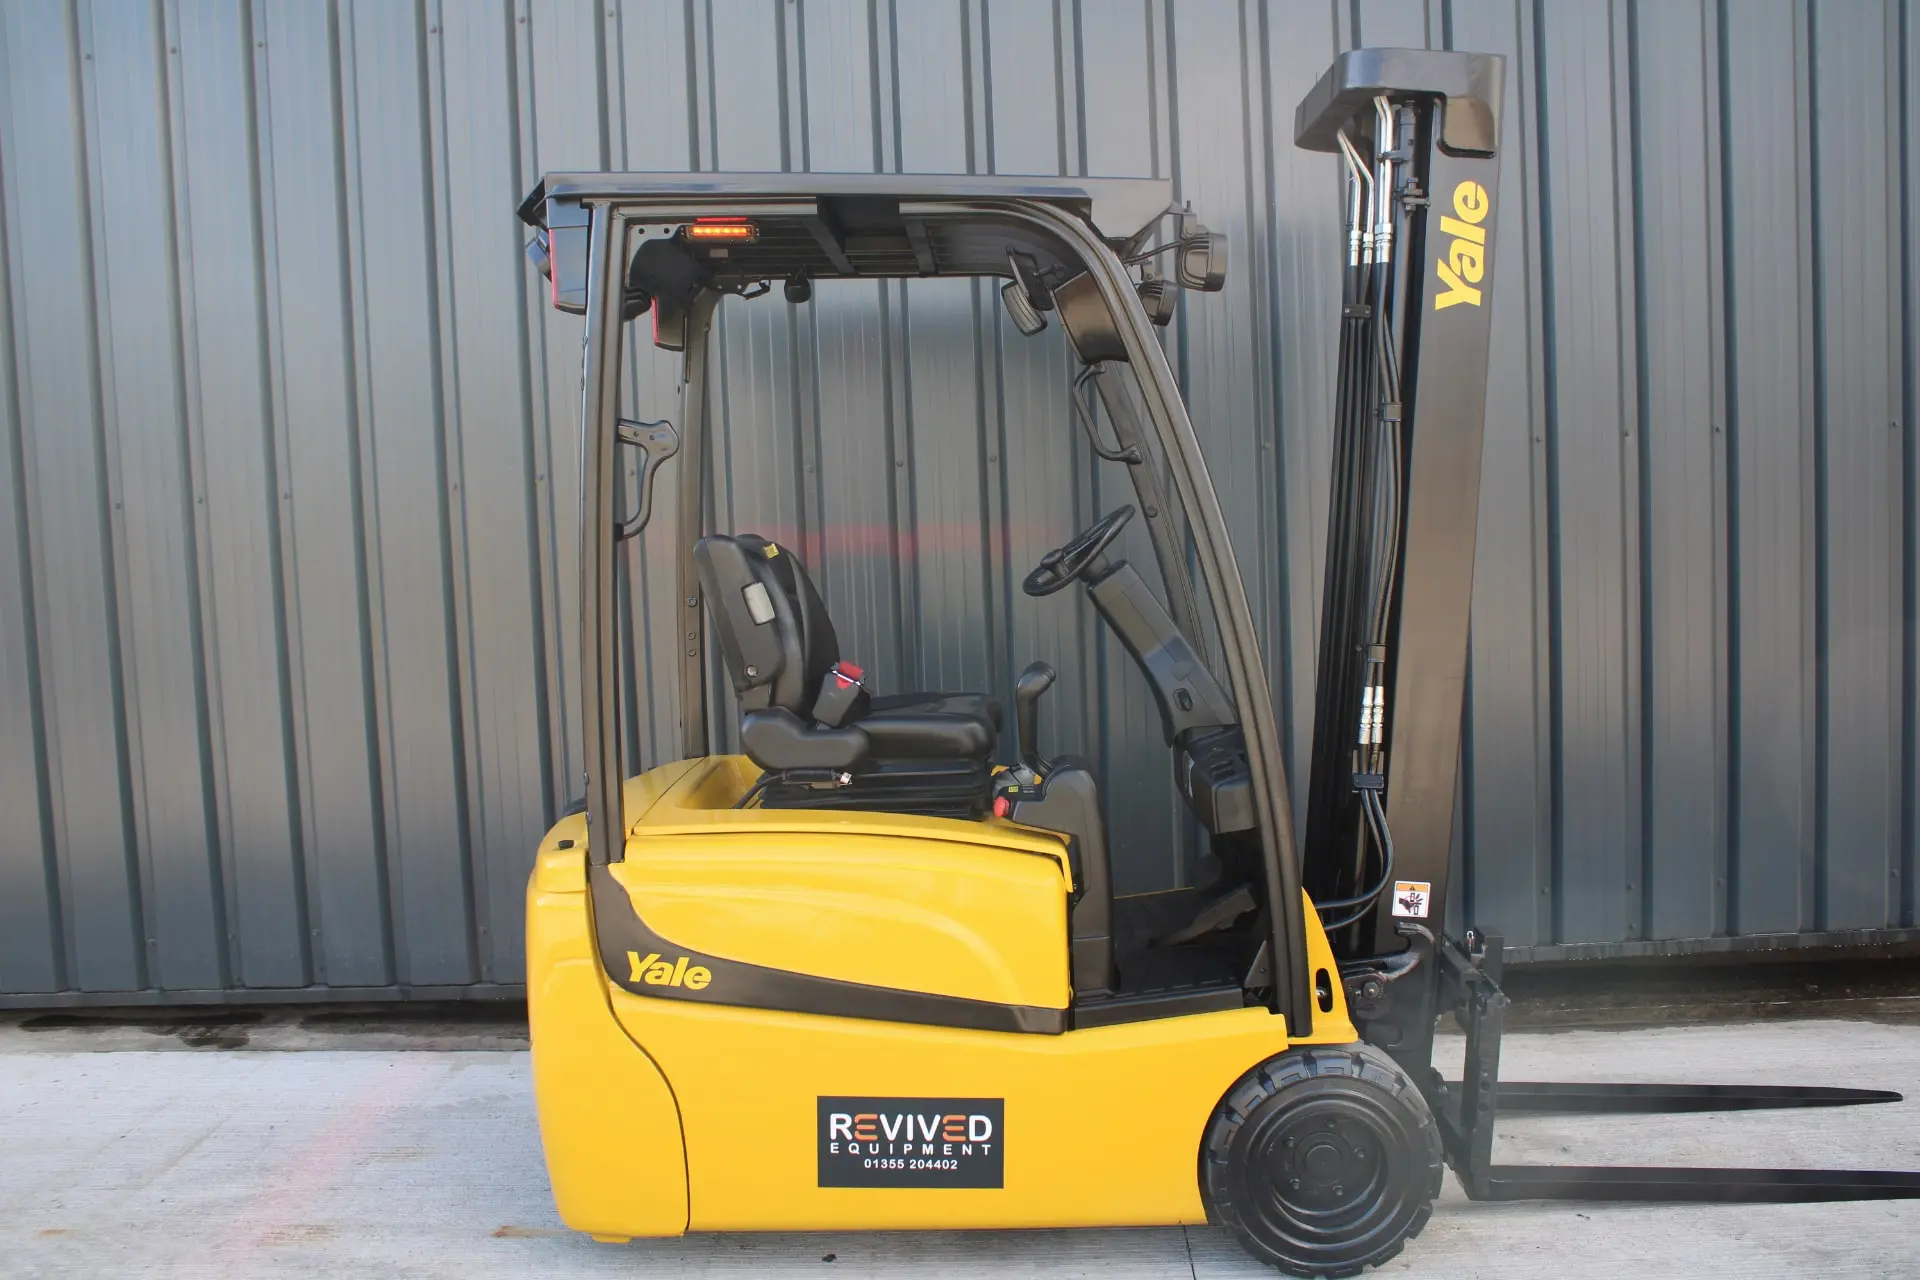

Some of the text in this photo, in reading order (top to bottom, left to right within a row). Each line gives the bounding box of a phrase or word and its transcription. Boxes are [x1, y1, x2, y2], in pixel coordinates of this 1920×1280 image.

[1435, 181, 1490, 311] Yale
[626, 951, 712, 990] Yale
[830, 1113, 993, 1142] REVIVED
[830, 1142, 991, 1156] EQUIPMENT
[864, 1158, 958, 1170] 01355 204402
